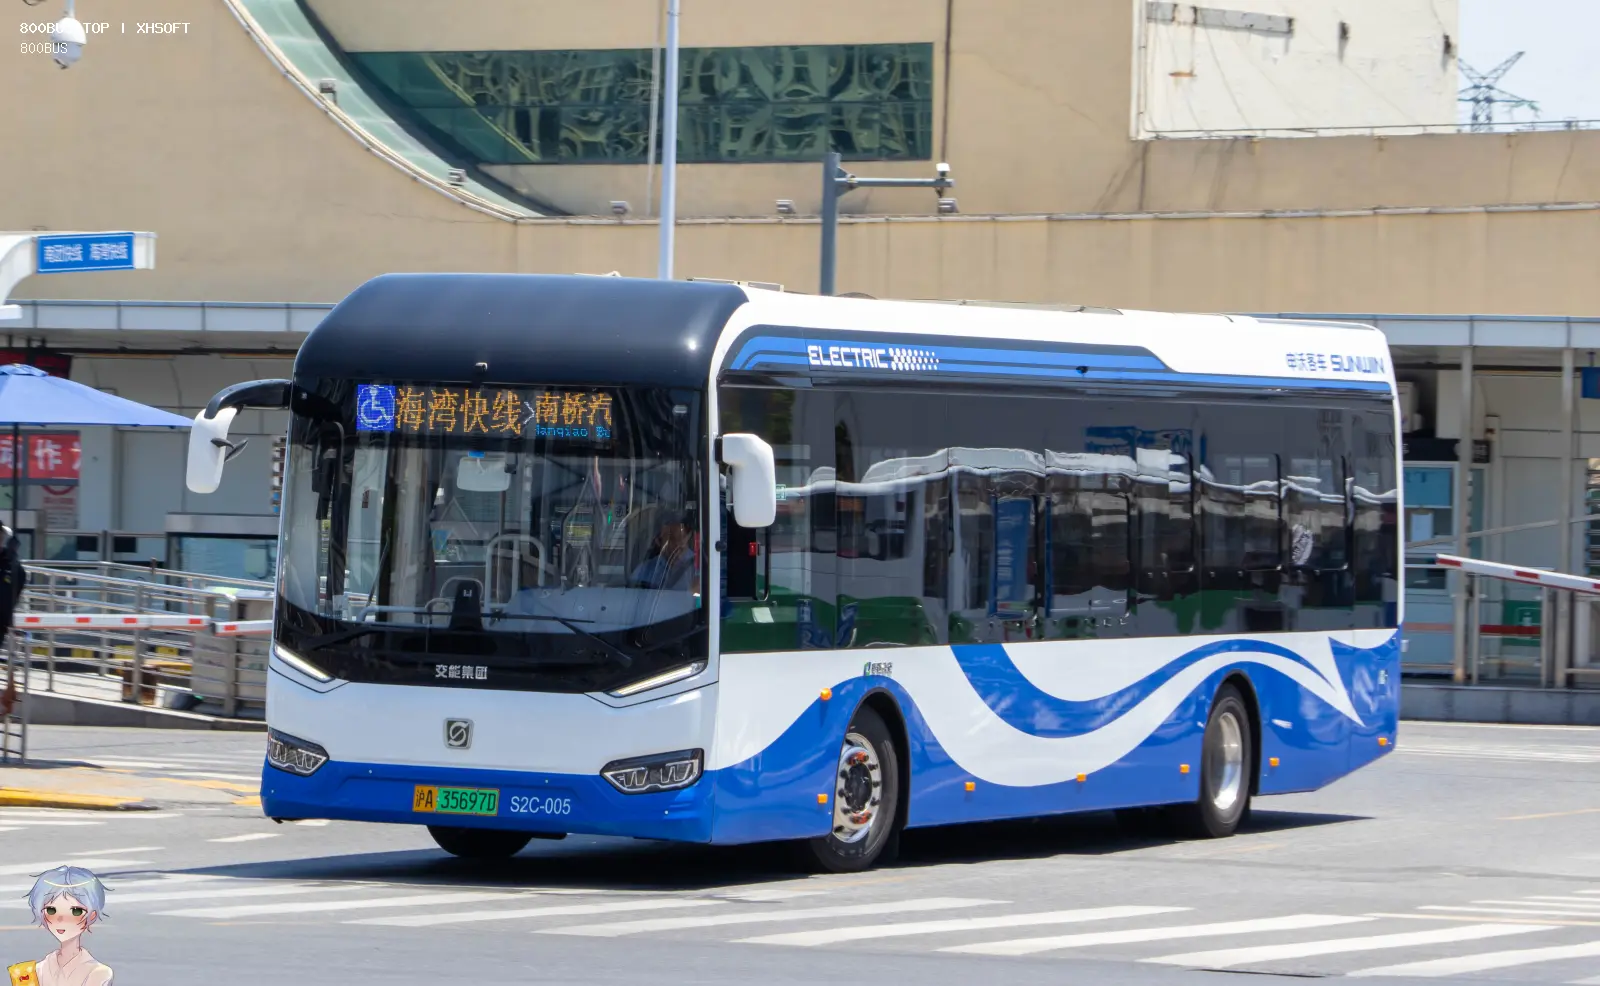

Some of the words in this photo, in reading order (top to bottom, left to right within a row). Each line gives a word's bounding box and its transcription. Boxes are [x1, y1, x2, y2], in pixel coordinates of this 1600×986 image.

[807, 345, 889, 369] ELECTRIC
[396, 386, 521, 435] 海湾快线
[435, 664, 488, 680] 交能集团
[510, 796, 571, 815] S2C-005
